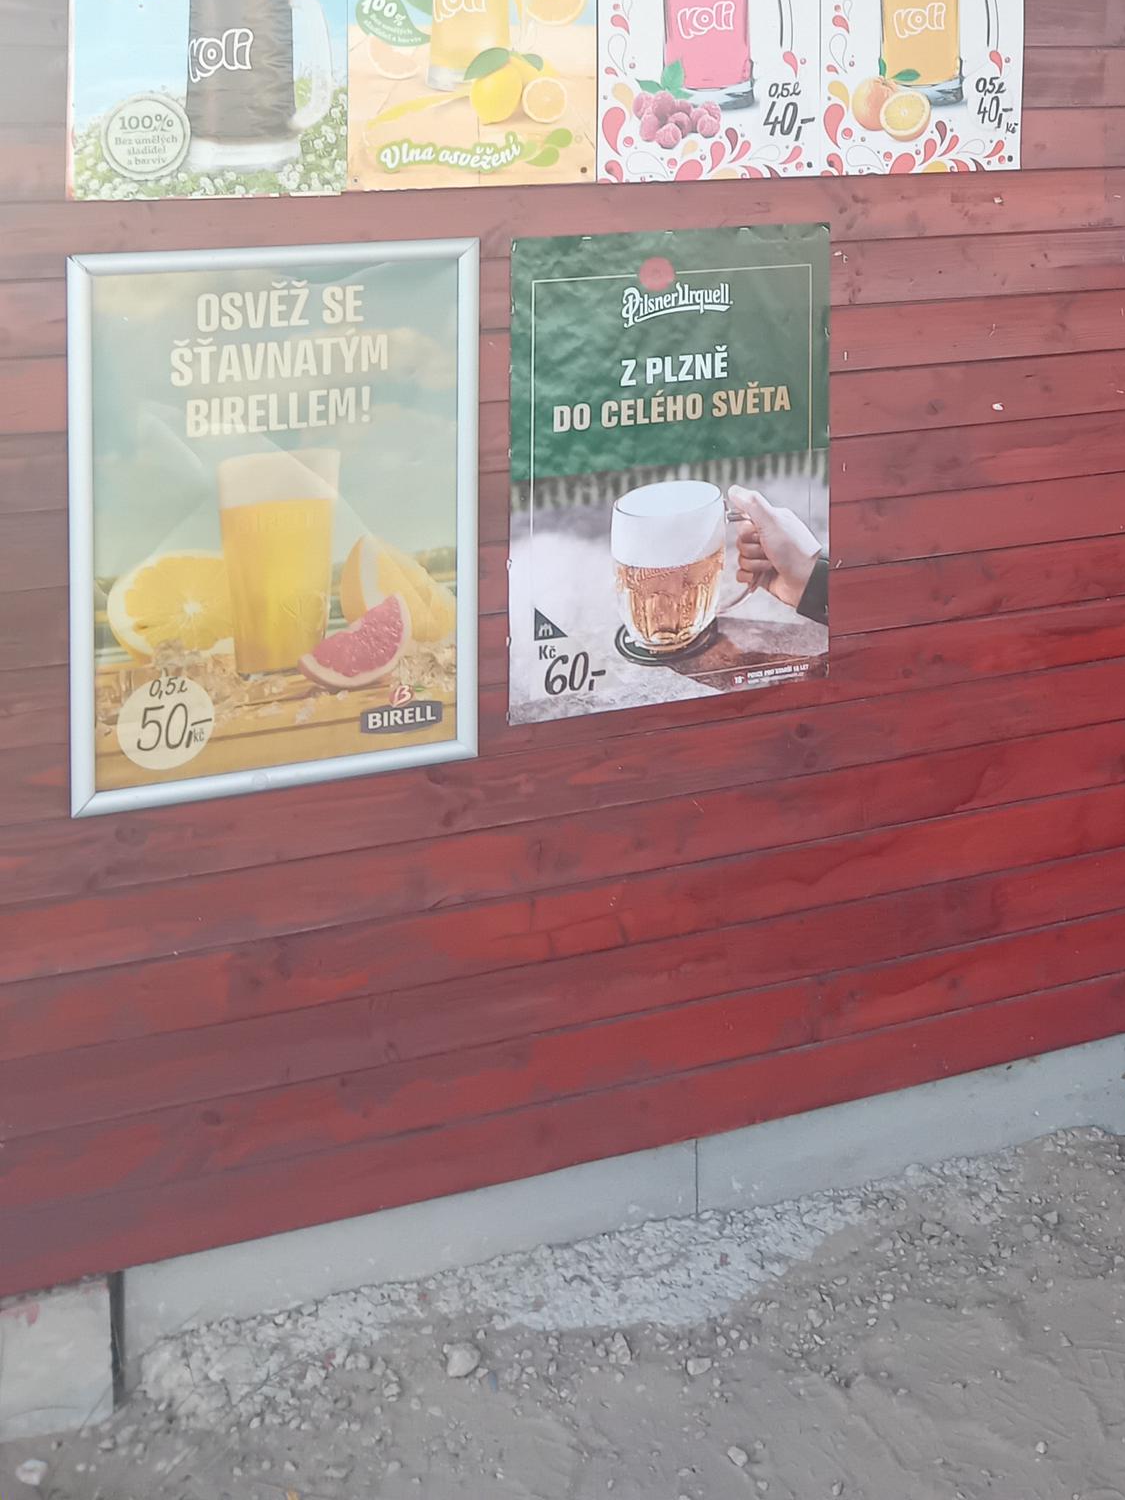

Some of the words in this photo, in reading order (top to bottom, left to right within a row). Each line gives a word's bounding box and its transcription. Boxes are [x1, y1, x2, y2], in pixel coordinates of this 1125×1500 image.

[119, 114, 174, 130] 100%
[380, 143, 435, 169] Vlna
[439, 135, 521, 170] osvěžení
[196, 280, 310, 333] OSVĚŽ
[322, 285, 365, 325] SE
[622, 287, 679, 328] Pilsner
[170, 328, 389, 387] ŠŤAVNATÝM
[619, 359, 637, 387] Z
[646, 345, 728, 385] PLZNĚ
[186, 386, 371, 438] BIRELLEM!
[553, 403, 591, 433] DO
[601, 390, 703, 429] CELÉHO
[712, 381, 791, 418] SVĚTA
[538, 644, 557, 661] Kč
[367, 705, 437, 730] BIRELL
